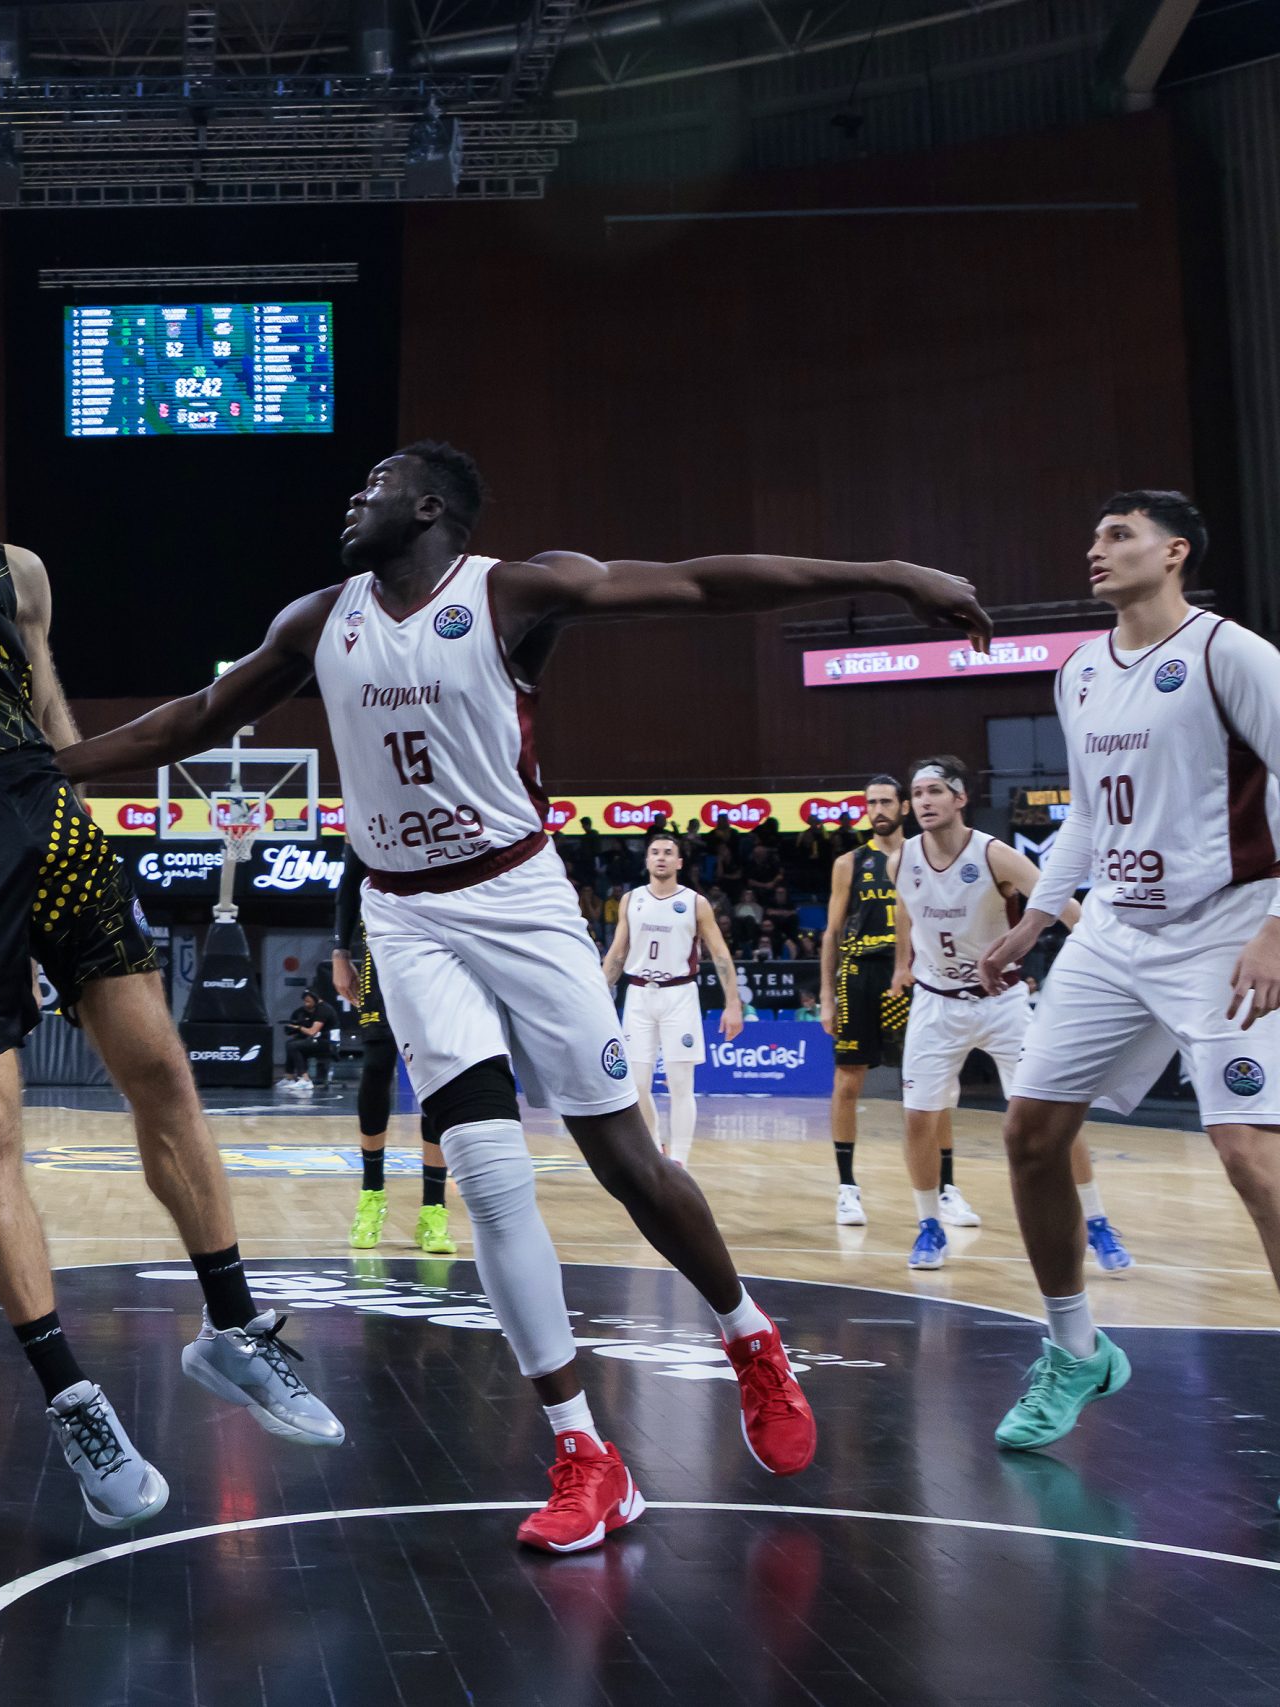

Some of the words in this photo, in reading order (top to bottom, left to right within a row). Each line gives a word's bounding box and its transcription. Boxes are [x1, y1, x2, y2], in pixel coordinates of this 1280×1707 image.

[825, 654, 919, 679] ARGELIO
[361, 680, 440, 711] Trapani
[1084, 728, 1151, 756] Trapani
[383, 730, 434, 785] 15
[1099, 774, 1135, 826] 10
[649, 940, 659, 960] 0
[939, 931, 957, 958] 5
[190, 1051, 240, 1060] EXPRESS
